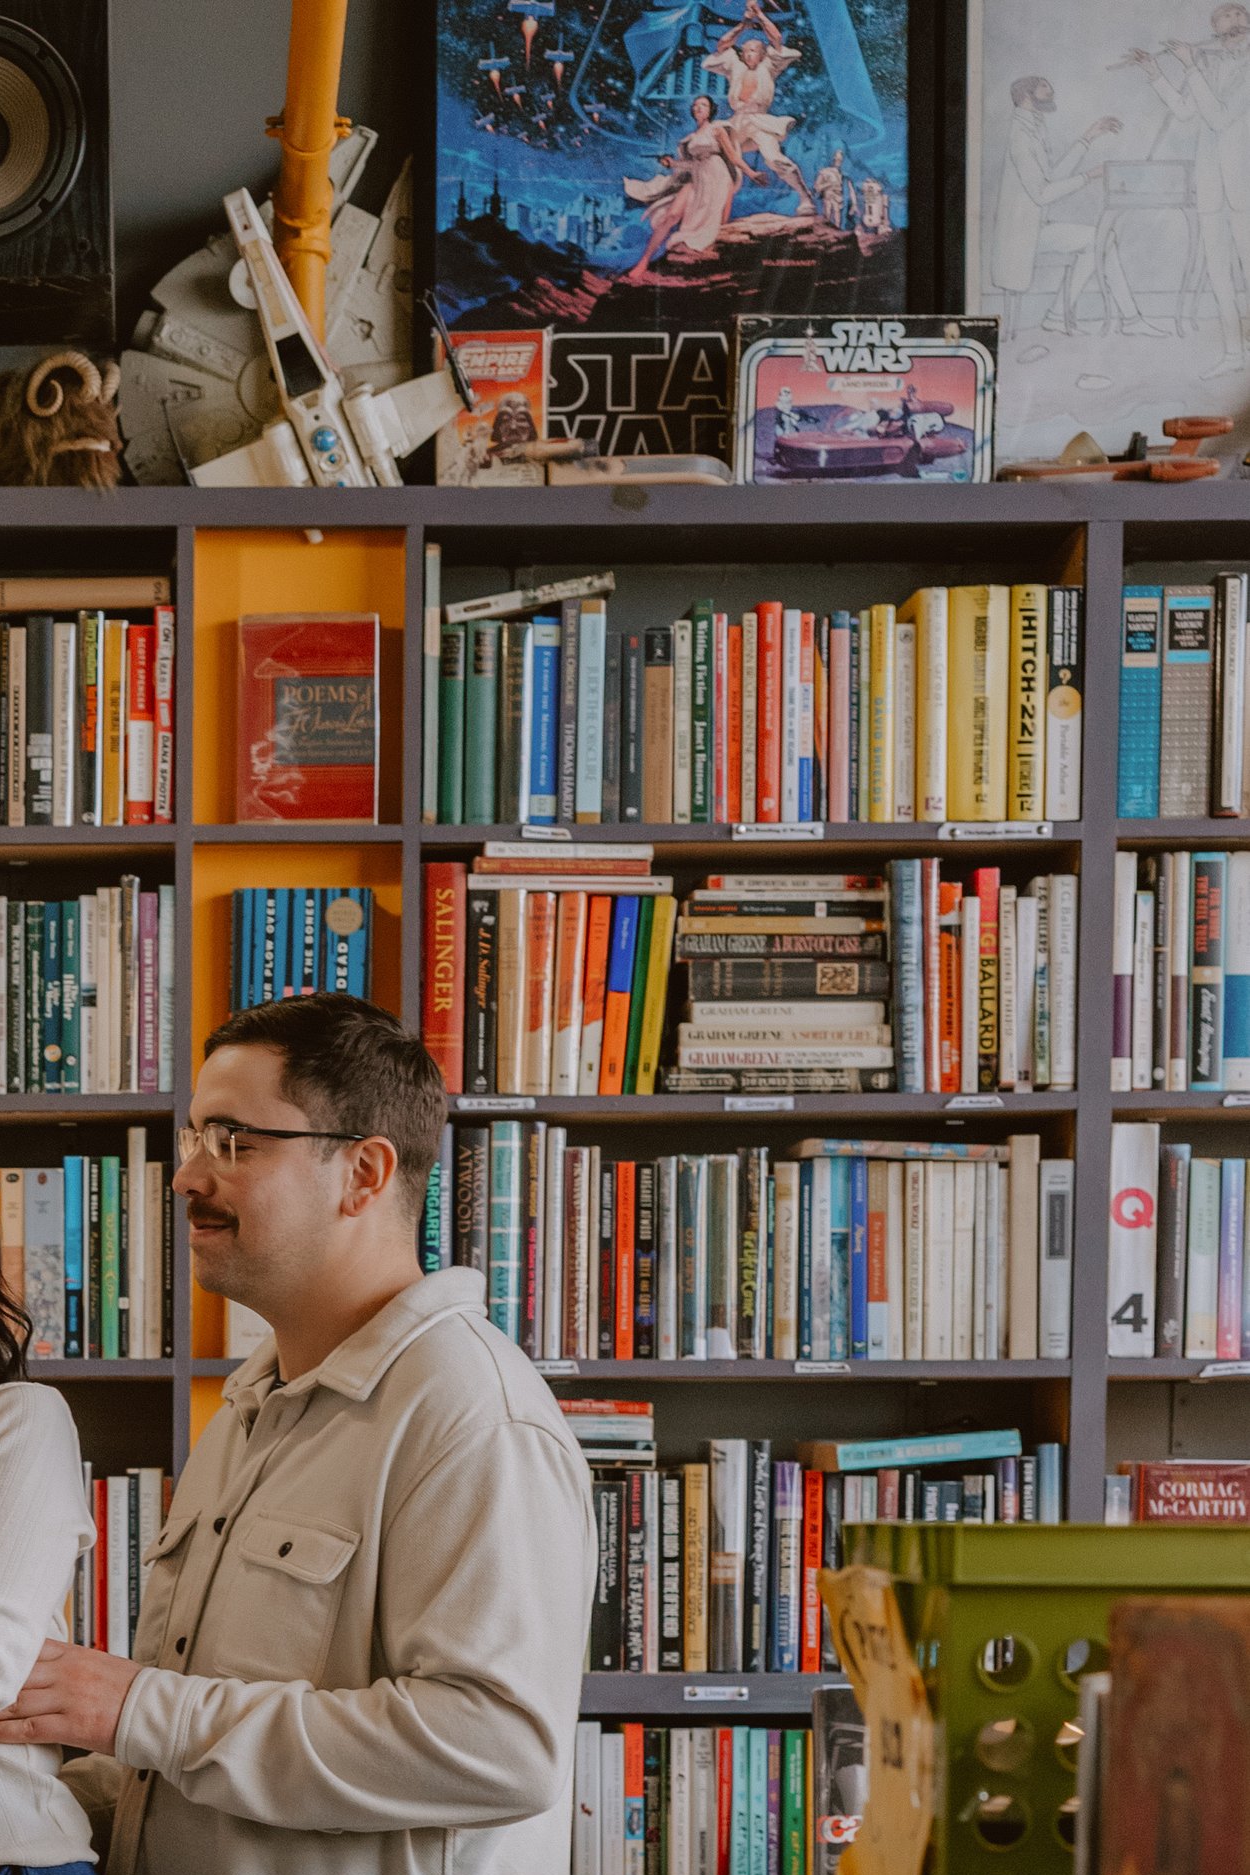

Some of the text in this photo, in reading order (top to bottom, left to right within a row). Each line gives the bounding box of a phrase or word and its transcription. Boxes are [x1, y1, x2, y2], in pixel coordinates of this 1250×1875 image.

[462, 352, 532, 367] EMPIRE
[823, 346, 914, 372] WARS
[831, 321, 907, 347] STAR
[549, 332, 730, 411] STA
[695, 620, 708, 705] Writing Fiction
[1020, 615, 1038, 737] HITCH-22
[282, 684, 359, 705] POEMS
[157, 734, 171, 811] DANA SPIOTTA
[562, 721, 575, 819] THOMAS HARDY
[872, 697, 884, 804] DAVID SHIELDS
[263, 898, 276, 978] PLOW OVER
[303, 898, 315, 975] THE BONES
[1037, 907, 1047, 954] BALLARD
[1059, 906, 1072, 955] Ballard
[1195, 876, 1208, 952] THE BELL TOLLS
[1208, 887, 1221, 940] FOR WHOM
[335, 941, 349, 990] DEAD
[433, 889, 456, 1013] SALINGER
[685, 935, 767, 953] GRAHAM GREENE
[837, 935, 861, 952] CASE
[474, 957, 491, 1010] Salinger
[981, 958, 997, 1051] BALLARD
[144, 967, 153, 1059] THESE STREETS
[688, 1031, 783, 1040] GRAHAM GREENE
[700, 1007, 793, 1015] GRAHAM GREENE
[831, 1031, 843, 1040] OF
[1197, 988, 1216, 1077] Ernest Hemingway
[689, 1053, 783, 1064] GRAHAM GREENE
[437, 1169, 450, 1254] THE TESTAMENTS
[457, 1145, 471, 1233] ATWOOD
[473, 1144, 484, 1232] MARGARET
[602, 1172, 611, 1239] MARGARET ATWOOD
[639, 1168, 652, 1240] MARGARET ATWOOD
[1111, 1187, 1154, 1230] Q
[1111, 1292, 1149, 1333] 4
[609, 1492, 617, 1516] MARIO
[1150, 1500, 1247, 1516] McCARTHY
[1158, 1481, 1239, 1498] CORMAC
[688, 1552, 696, 1637] SPECIAL SERVICE
